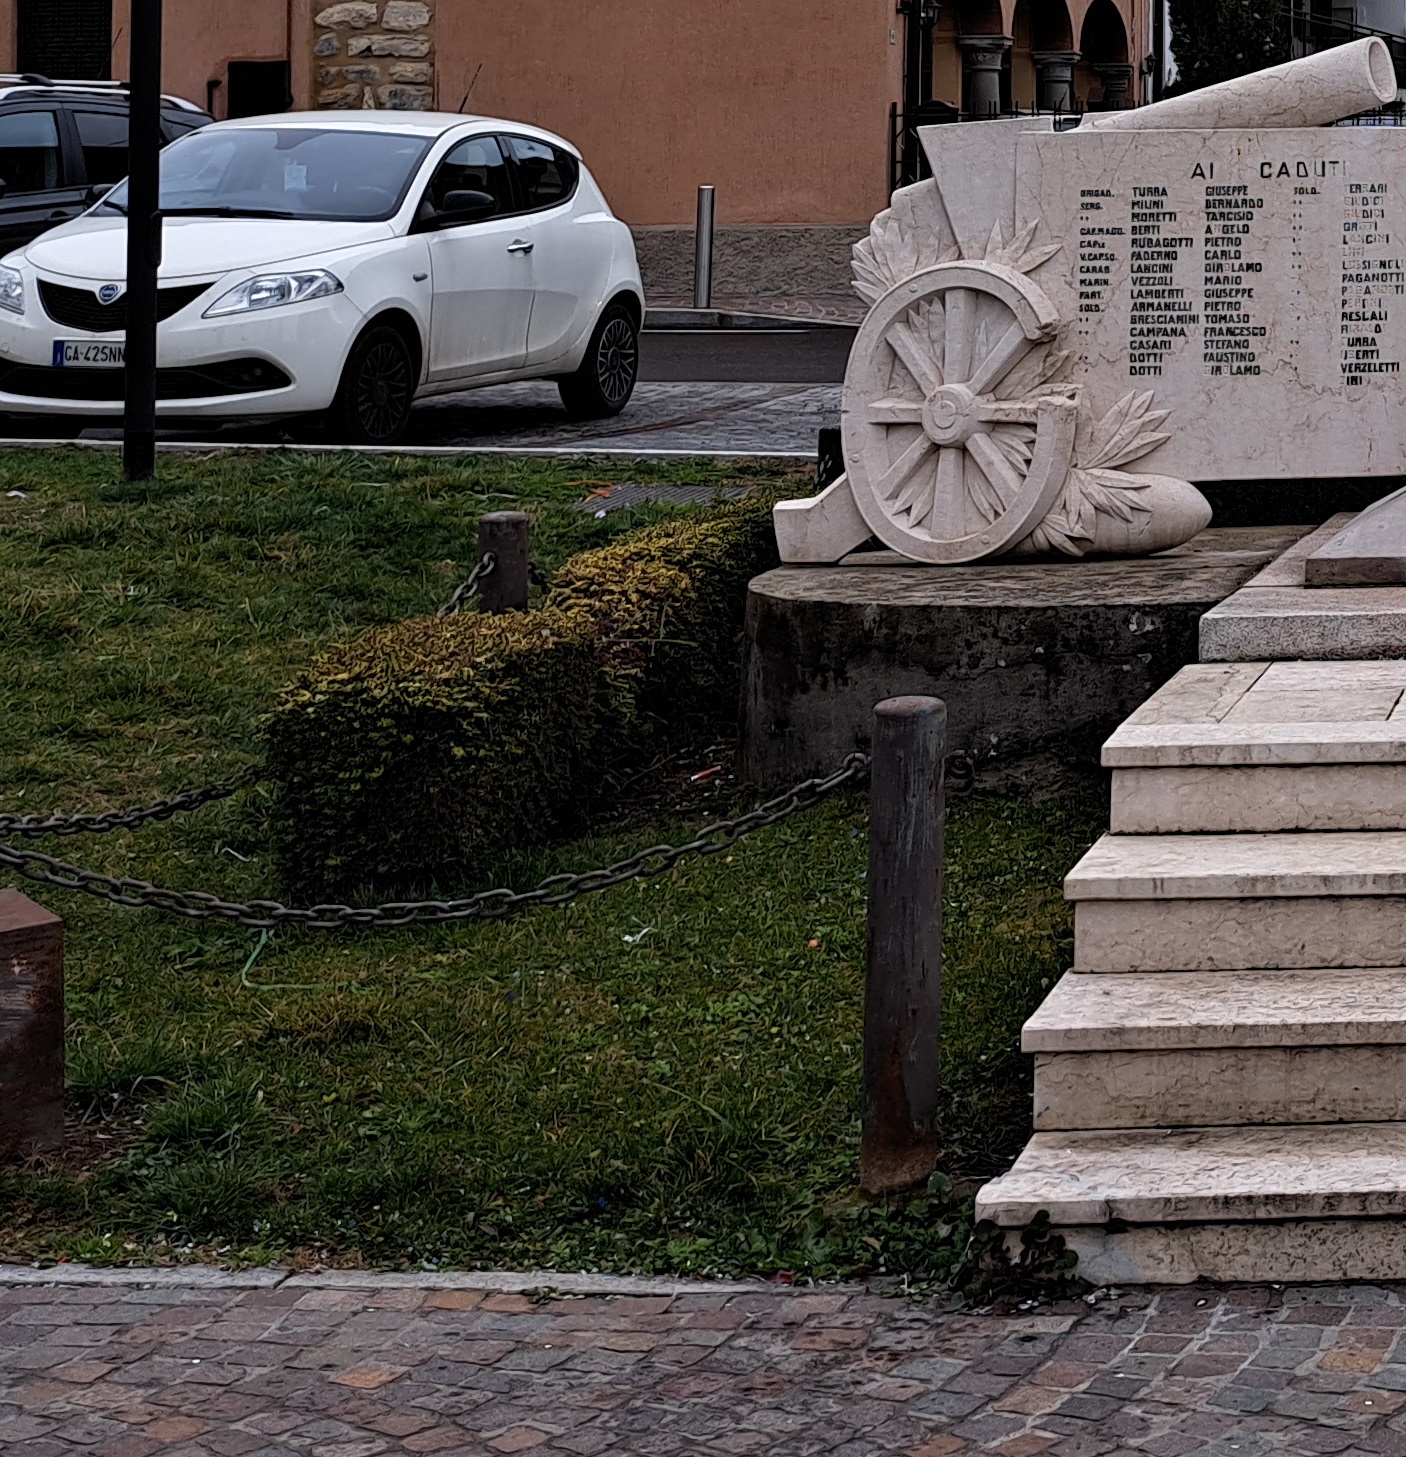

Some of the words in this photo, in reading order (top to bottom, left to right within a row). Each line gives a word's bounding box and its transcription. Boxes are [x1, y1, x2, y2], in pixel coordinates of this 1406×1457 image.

[1191, 162, 1213, 179] AI
[1260, 161, 1346, 178] CADUTI
[1206, 185, 1248, 196] GIUSEPPE
[1205, 199, 1263, 208] BERNARDO
[1131, 212, 1176, 222] MORETTI
[1205, 212, 1253, 221] TARCISIO
[1205, 237, 1241, 247] PIETRO
[1205, 250, 1241, 260] CARLO
[1131, 264, 1172, 273] LANCINI
[1131, 276, 1172, 286] VEZZOLI
[1205, 276, 1242, 285] MARIO
[1342, 272, 1404, 283] PAGANOTTI
[1205, 288, 1254, 298] GIUSEPPE
[1131, 302, 1192, 312] ARMANELLI
[1204, 302, 1241, 311] PIETRO
[1205, 314, 1249, 323] TOMASO
[1130, 327, 1187, 337] CAMPANA
[1204, 327, 1266, 338] FRANCESCO
[1204, 339, 1249, 349] STEFANO
[1130, 353, 1163, 363] DOTTI
[1204, 352, 1255, 362] FAUSTINO
[1130, 366, 1161, 375] DOTTI
[1341, 362, 1399, 374] VERZELETTI
